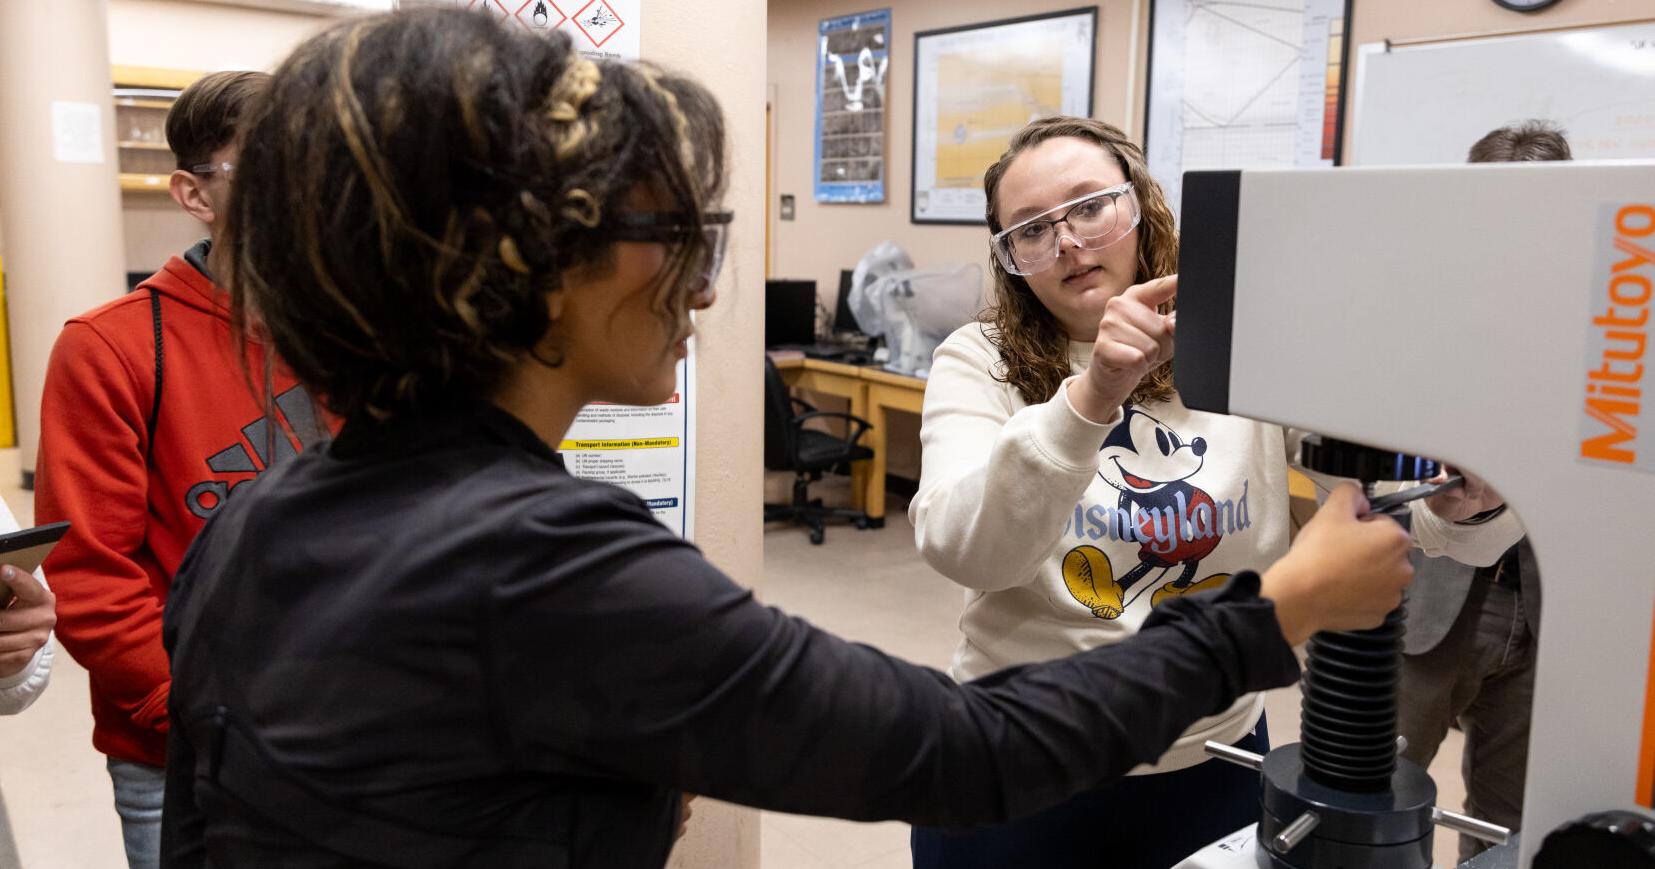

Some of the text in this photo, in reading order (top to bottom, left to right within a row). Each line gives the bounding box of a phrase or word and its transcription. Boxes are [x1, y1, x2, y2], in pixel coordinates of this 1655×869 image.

[1579, 203, 1655, 464] Mitutoyo
[601, 440, 630, 448] Information
[631, 439, 672, 447] (Non-Mandatory)
[1064, 479, 1252, 554] isneyland
